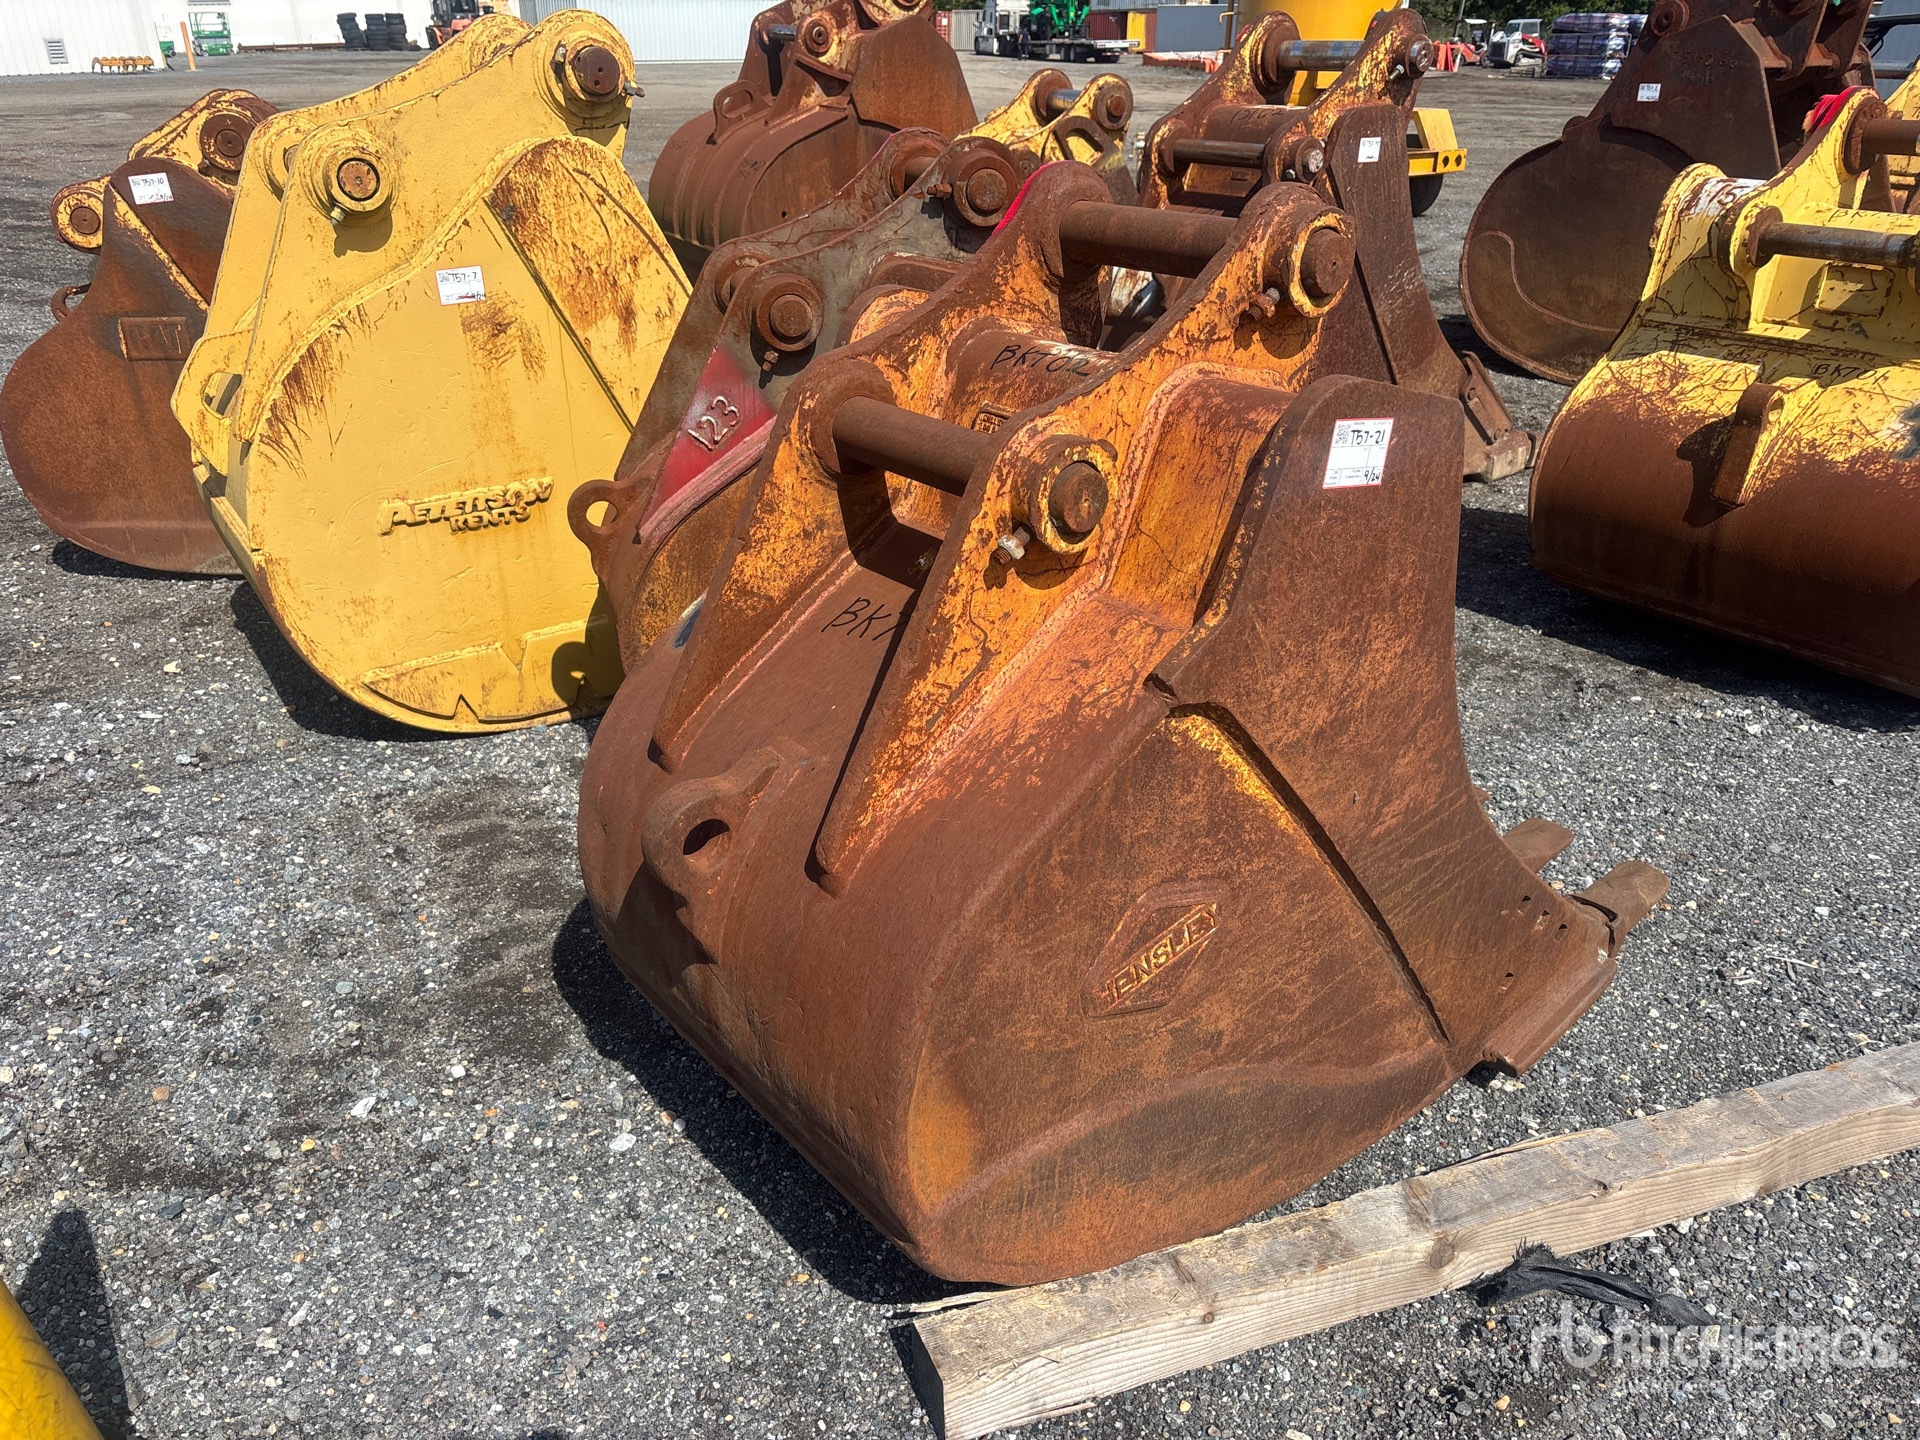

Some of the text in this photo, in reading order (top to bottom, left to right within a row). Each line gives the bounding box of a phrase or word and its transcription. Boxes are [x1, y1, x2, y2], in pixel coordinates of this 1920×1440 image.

[447, 271, 477, 283] T57-7
[687, 395, 740, 452] 123
[1350, 428, 1386, 446] T57-21
[1363, 466, 1381, 485] 9/24
[450, 506, 531, 535] RENTS
[1102, 902, 1218, 1006] HENSLEY
